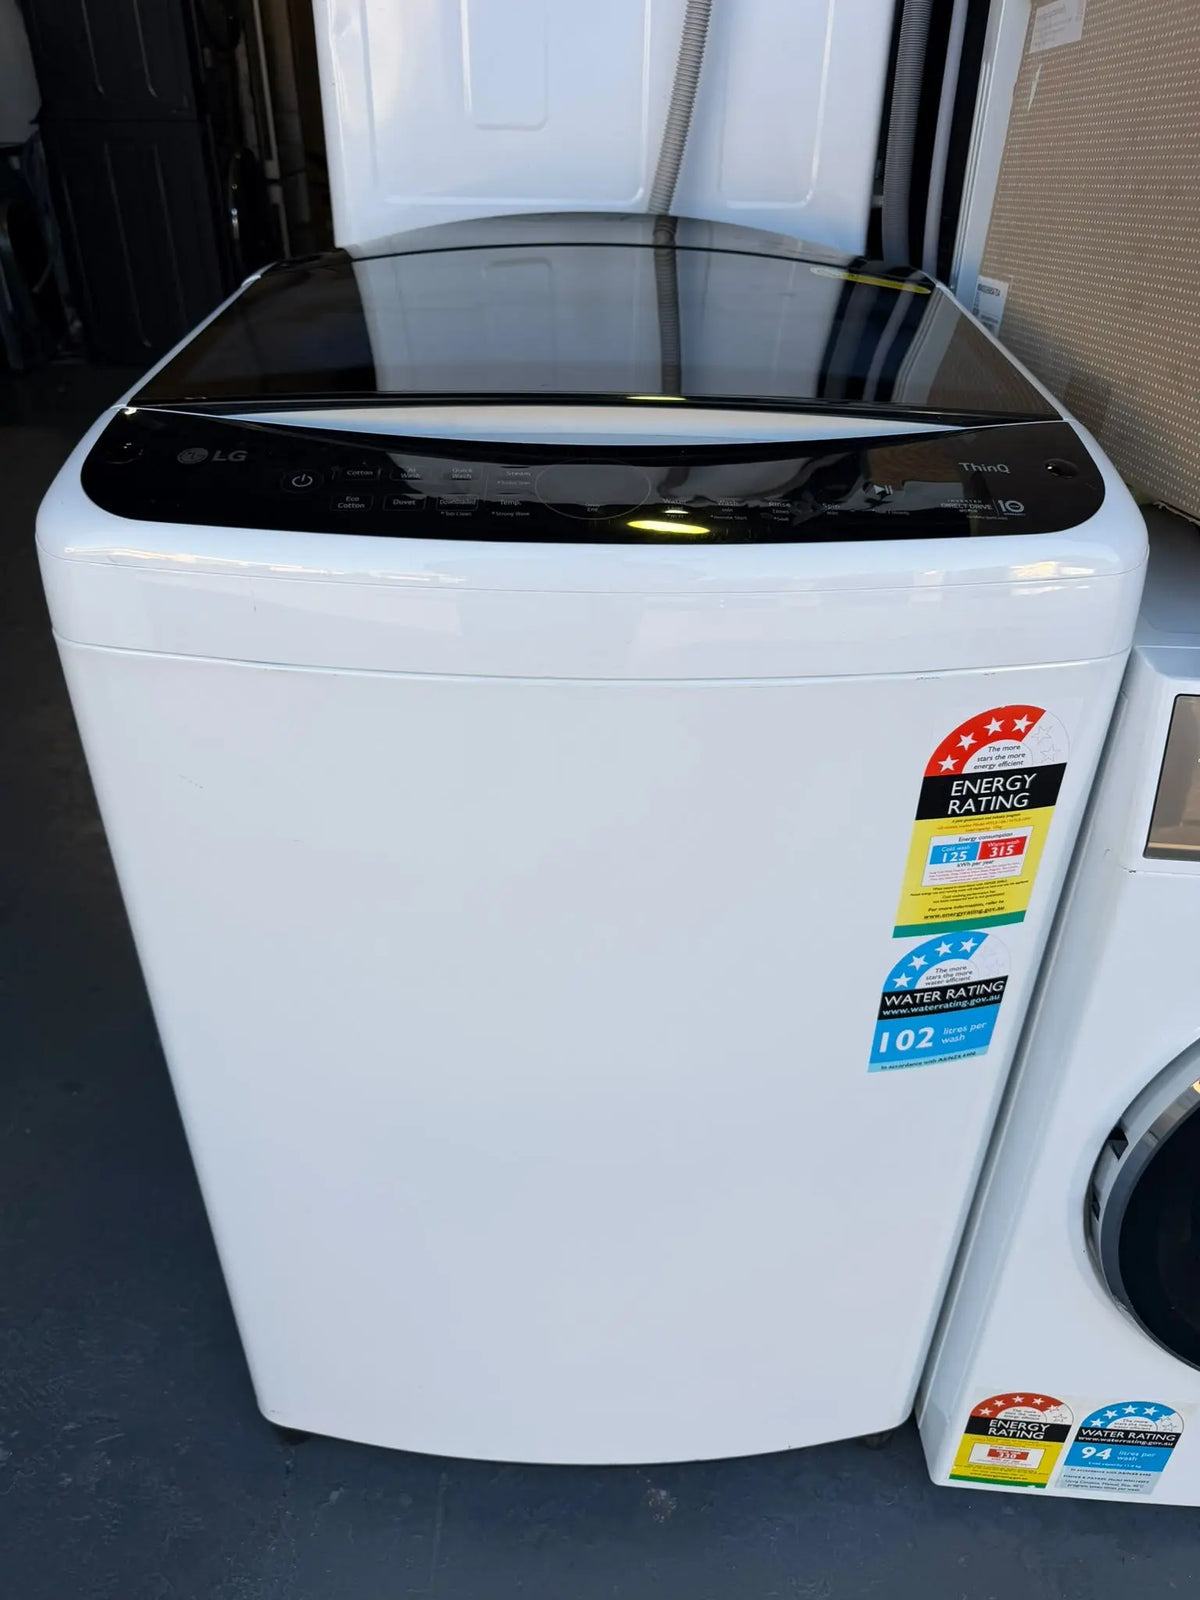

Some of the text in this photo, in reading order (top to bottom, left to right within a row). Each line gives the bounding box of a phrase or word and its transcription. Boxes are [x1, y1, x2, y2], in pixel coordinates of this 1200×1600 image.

[211, 450, 249, 462] LG
[346, 469, 374, 477] Cotton
[958, 462, 1011, 474] ThinQ
[337, 502, 366, 510] Cotton
[392, 498, 417, 507] Duvet
[998, 499, 1026, 513] 10
[995, 753, 1006, 761] the
[1007, 752, 1026, 760] more
[997, 760, 1024, 768] efficient
[951, 773, 1037, 797] ENERGY
[947, 792, 1030, 815] RATING
[978, 832, 1013, 841] consumption
[942, 850, 967, 863] 125
[989, 845, 1015, 858] 315
[884, 980, 1004, 1007] WATER RATING
[882, 994, 1001, 1016] www.waterrating.gov.au
[943, 1022, 988, 1035] litres per
[879, 1026, 935, 1053] 102
[941, 1034, 965, 1044] wash
[989, 1419, 1050, 1432] ENERGY
[988, 1427, 1045, 1440] RATING
[1081, 1429, 1177, 1442] WATER RATING
[1078, 1436, 1174, 1447] www.waterrating.gov.au
[1081, 1446, 1112, 1460] 94
